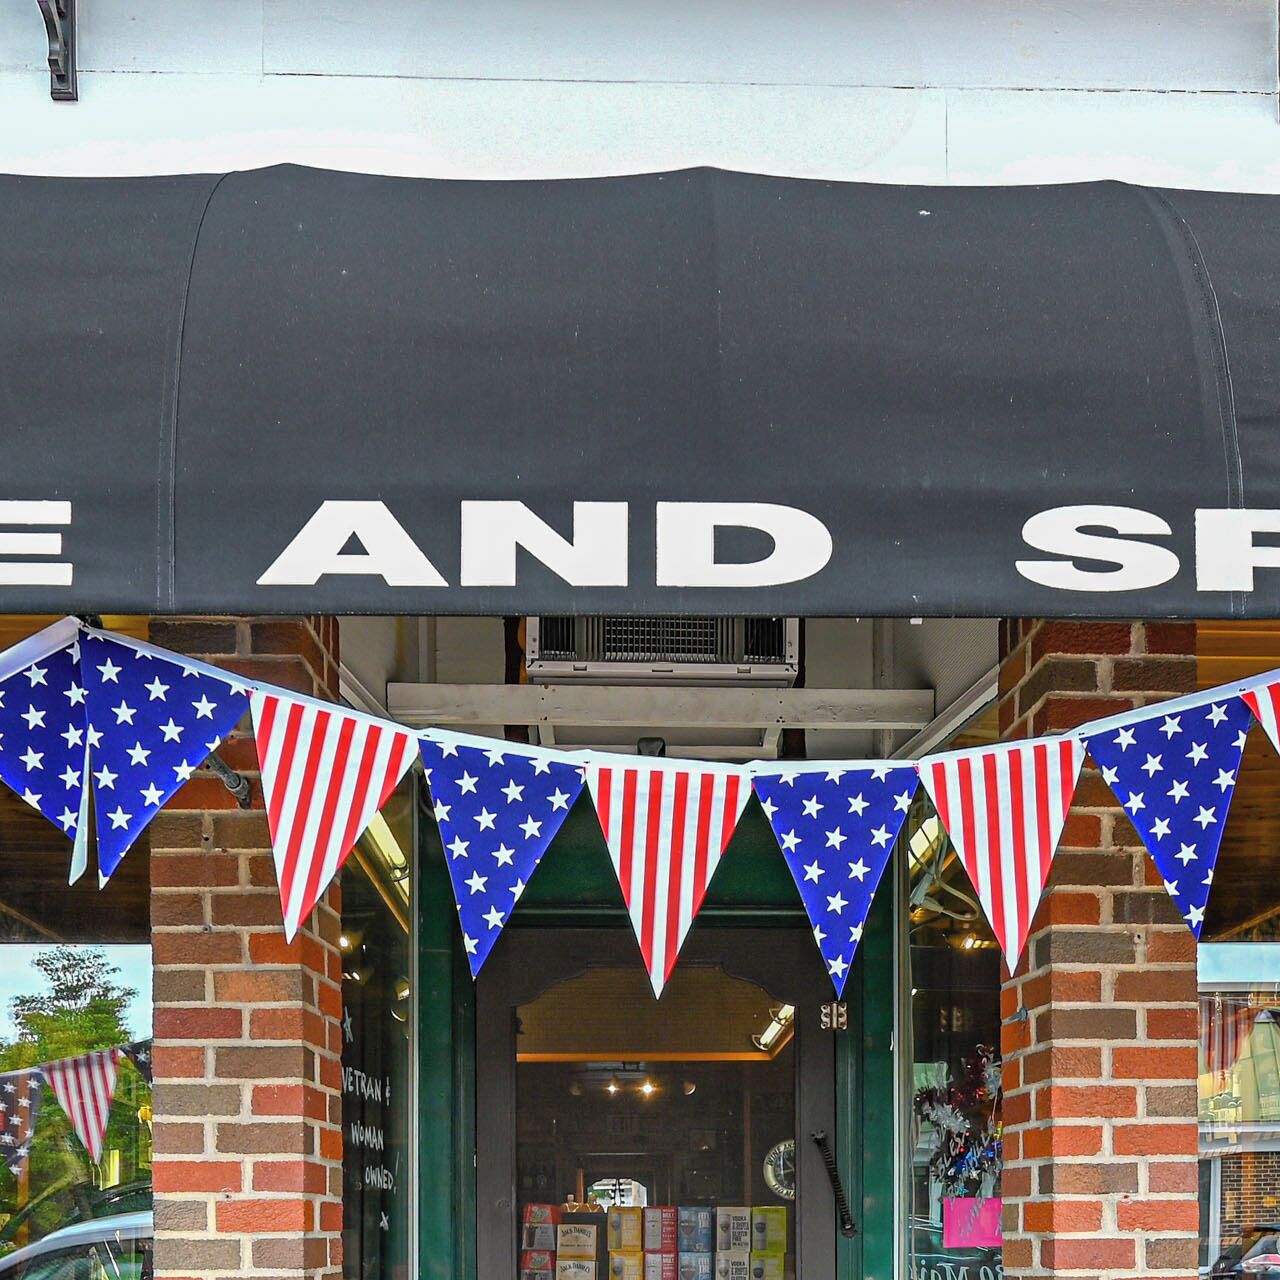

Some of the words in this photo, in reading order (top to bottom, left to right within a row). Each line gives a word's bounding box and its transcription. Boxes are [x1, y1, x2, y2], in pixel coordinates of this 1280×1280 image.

[256, 500, 833, 588] AND
[342, 1067, 381, 1102] VETRAN
[351, 1120, 384, 1151] WOMAN
